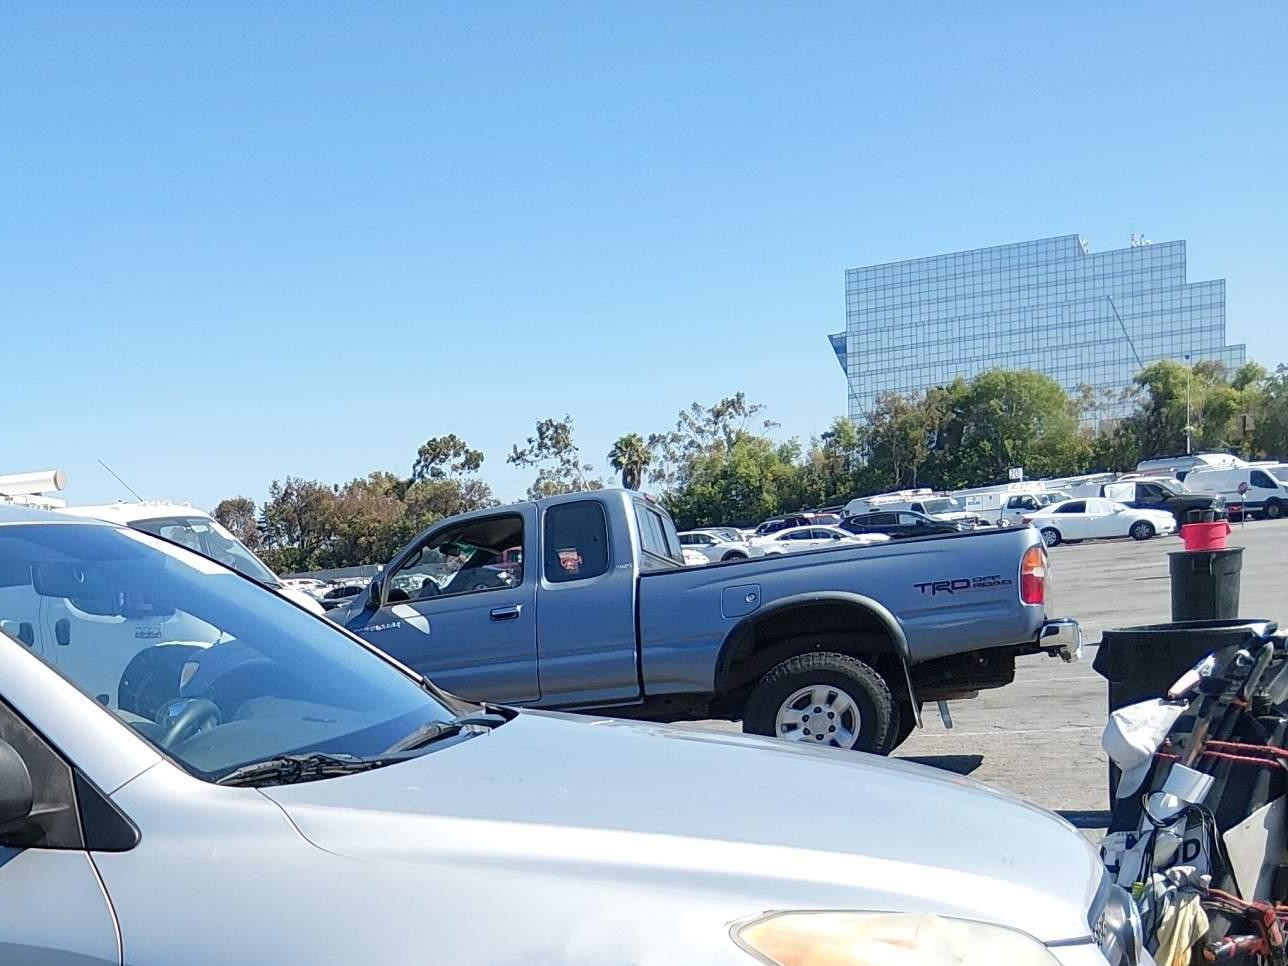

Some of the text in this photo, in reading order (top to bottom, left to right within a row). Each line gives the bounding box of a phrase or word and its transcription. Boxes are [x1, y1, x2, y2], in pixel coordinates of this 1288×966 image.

[972, 574, 1001, 582] OFF
[913, 579, 970, 596] TRD
[972, 579, 1013, 588] ROAD
